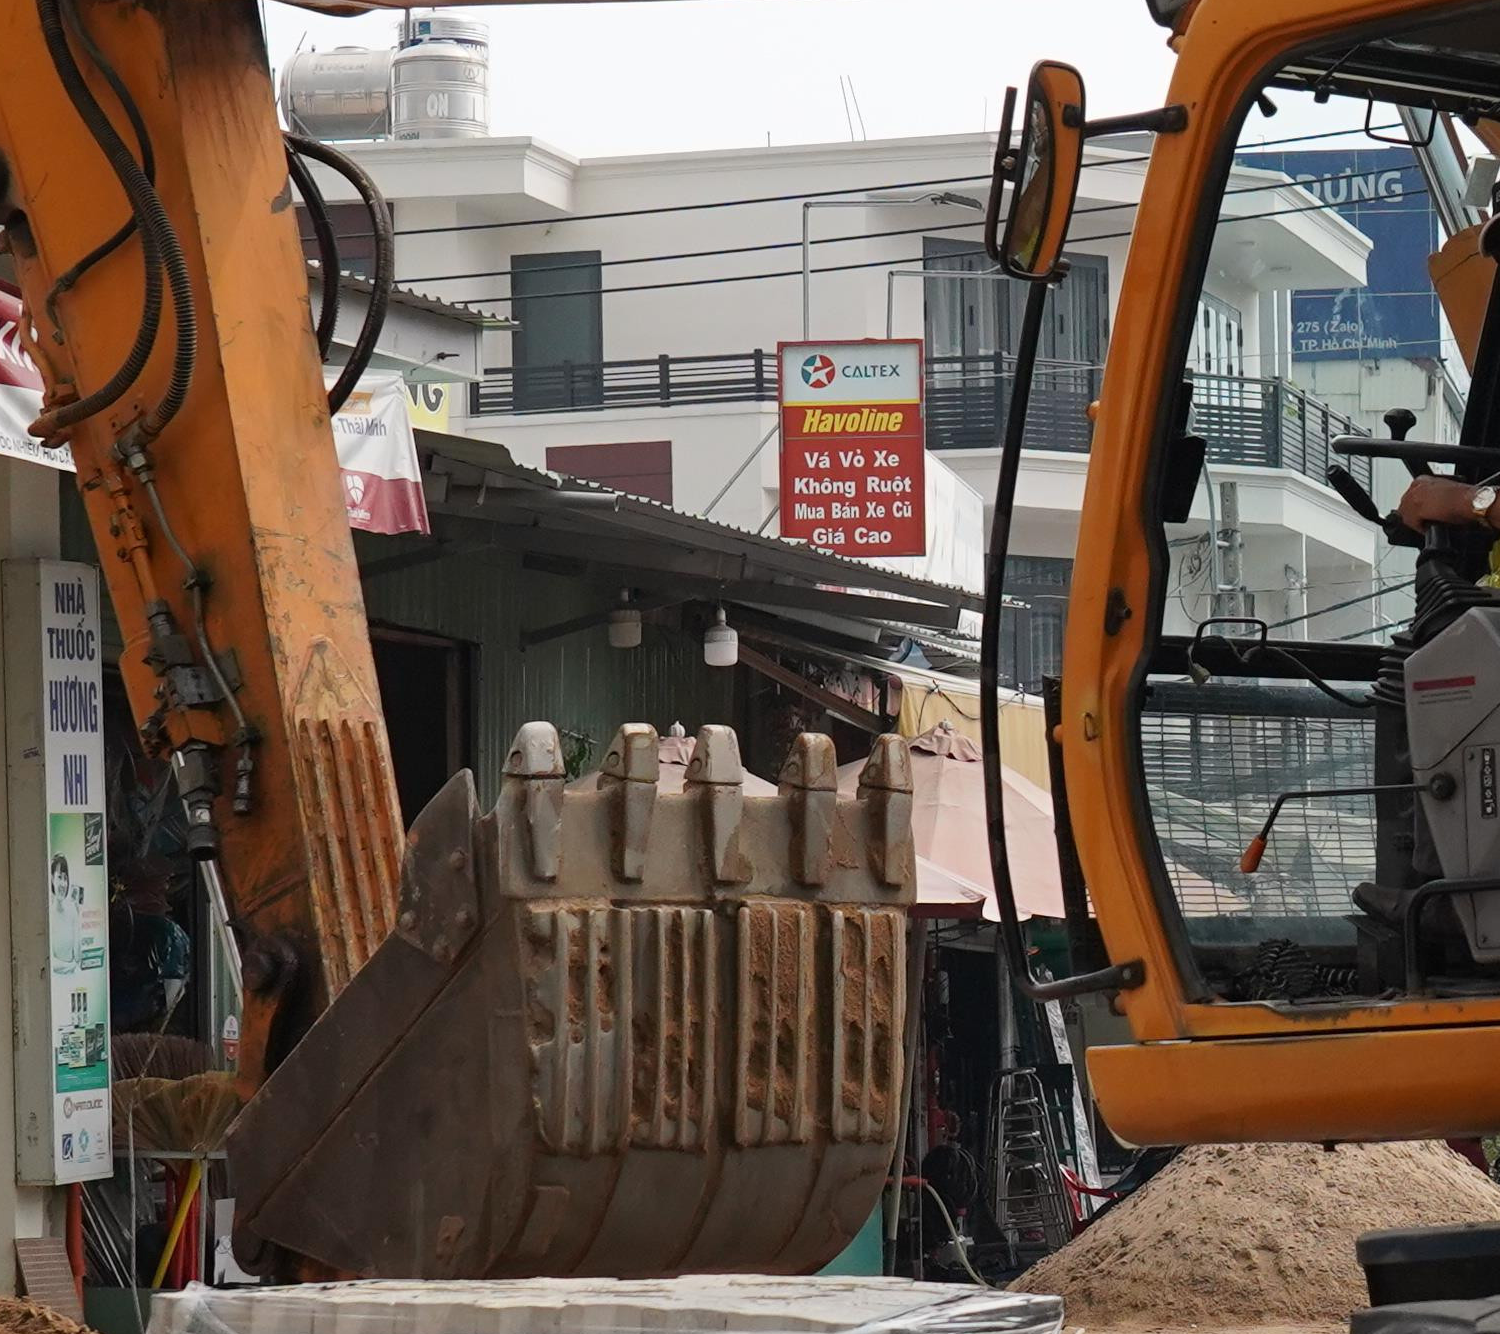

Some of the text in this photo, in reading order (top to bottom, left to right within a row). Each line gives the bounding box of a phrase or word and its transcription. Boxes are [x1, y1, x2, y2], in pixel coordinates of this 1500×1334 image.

[1300, 339, 1319, 351] TP.
[1367, 337, 1398, 350] Minh
[841, 364, 900, 379] CALTEX
[802, 408, 904, 434] Havoline
[804, 450, 900, 469] Vá Vỏ Xe
[794, 476, 912, 497] Không Ruột
[794, 500, 912, 519] Mua Bán Xe Cũ
[812, 527, 892, 545] Giá Cao
[54, 577, 86, 615] NHÀ
[47, 618, 95, 662] THUỐC
[49, 676, 98, 733] HƯƠNG
[63, 753, 89, 807] NHI
